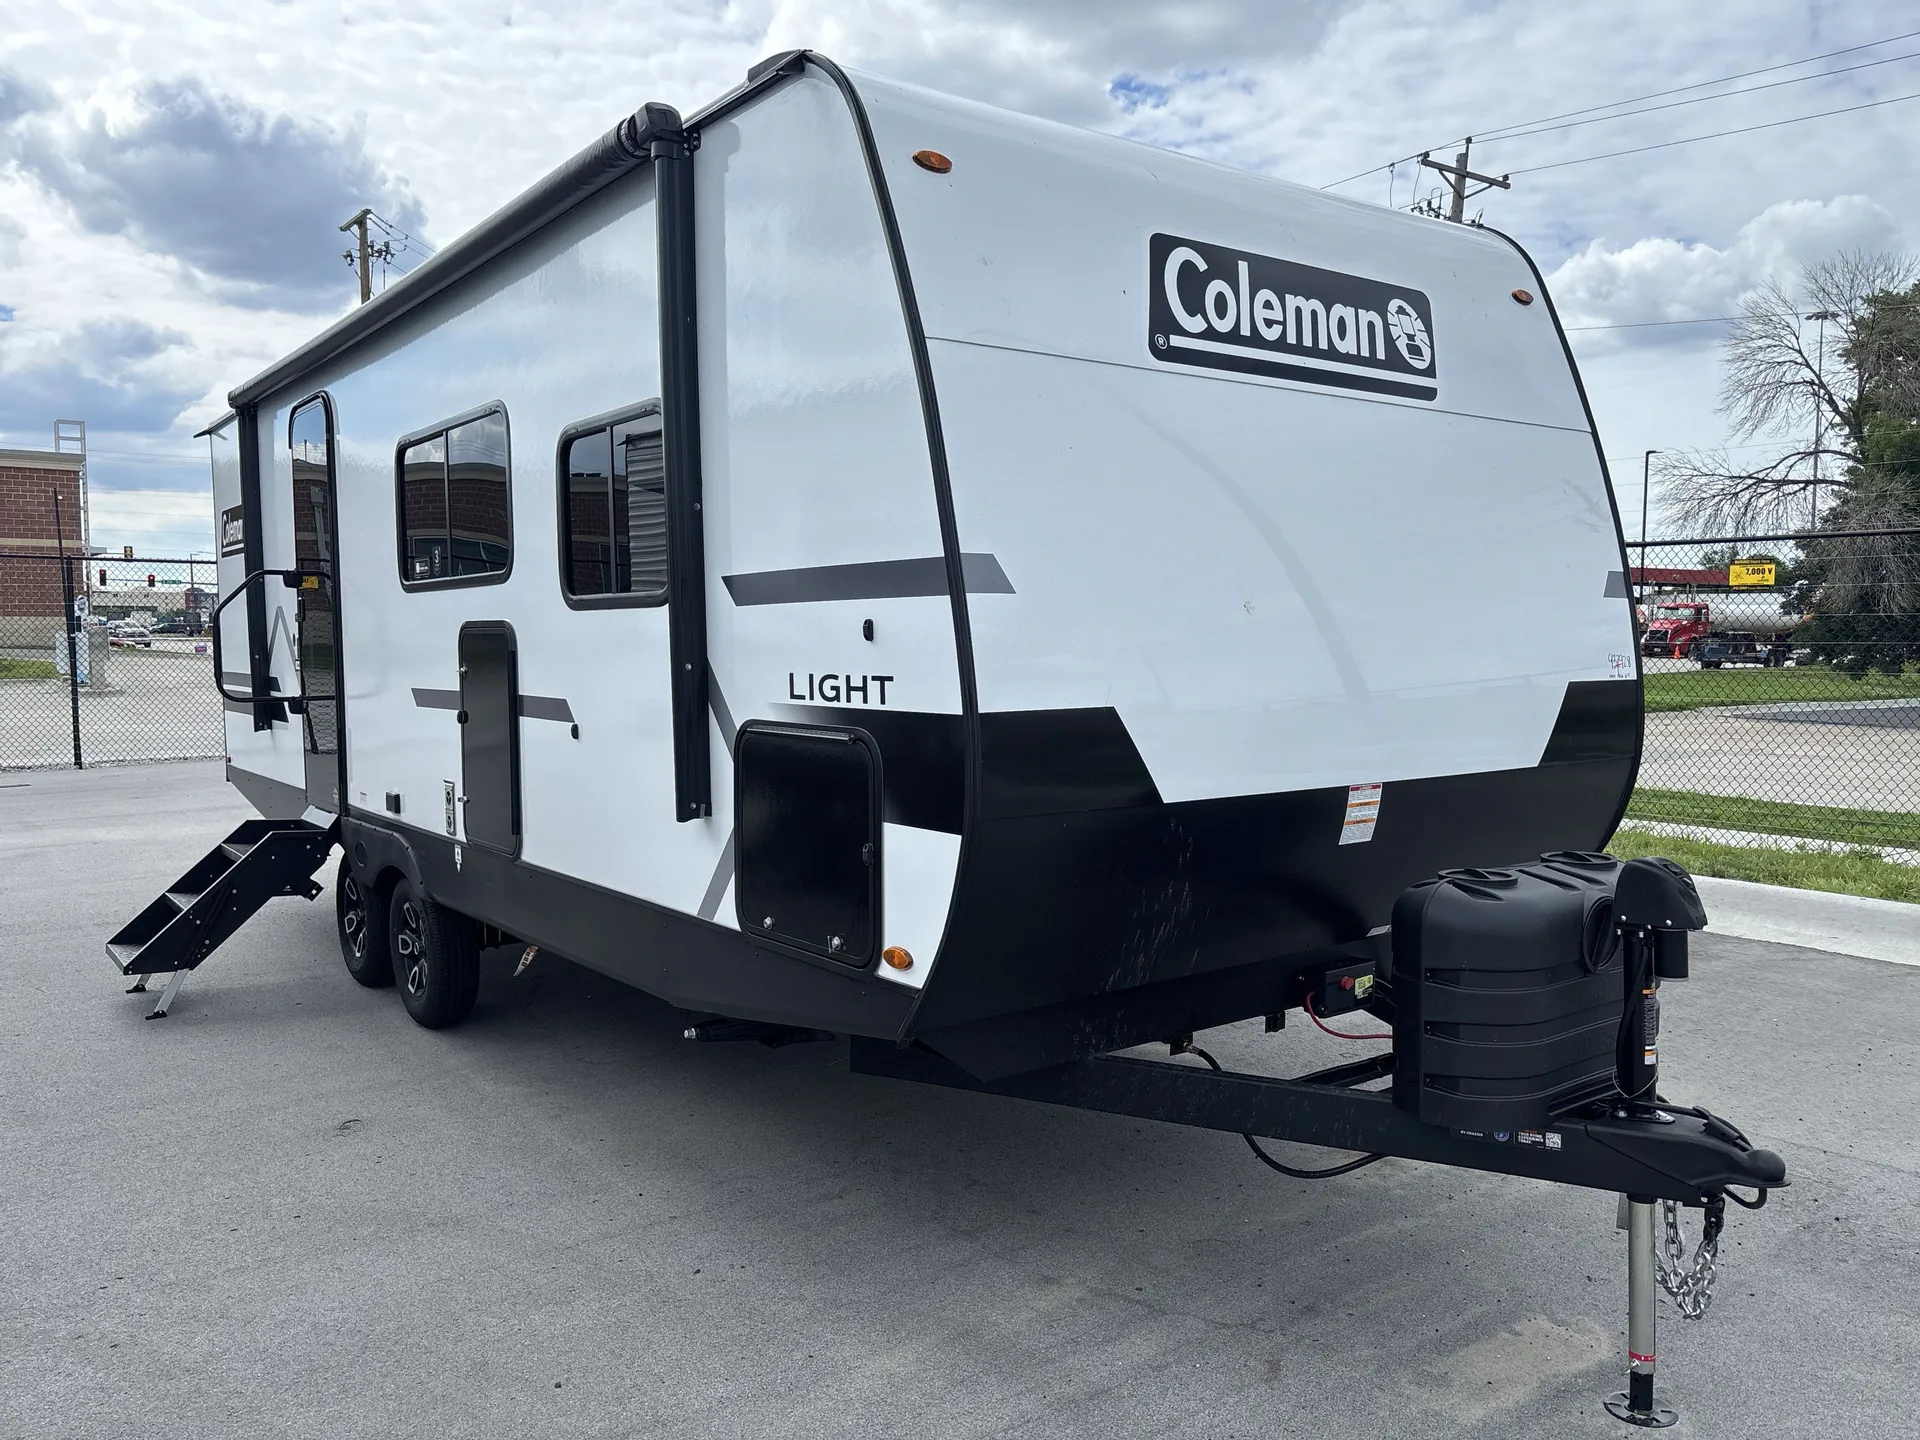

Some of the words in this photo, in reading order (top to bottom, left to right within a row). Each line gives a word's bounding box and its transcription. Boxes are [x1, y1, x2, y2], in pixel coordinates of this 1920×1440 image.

[1164, 246, 1386, 360] Coleman
[223, 512, 244, 546] Colema
[434, 549, 440, 564] 3
[1745, 567, 1766, 576] 7,000
[1767, 567, 1773, 575] V
[789, 673, 894, 705] LIGHT
